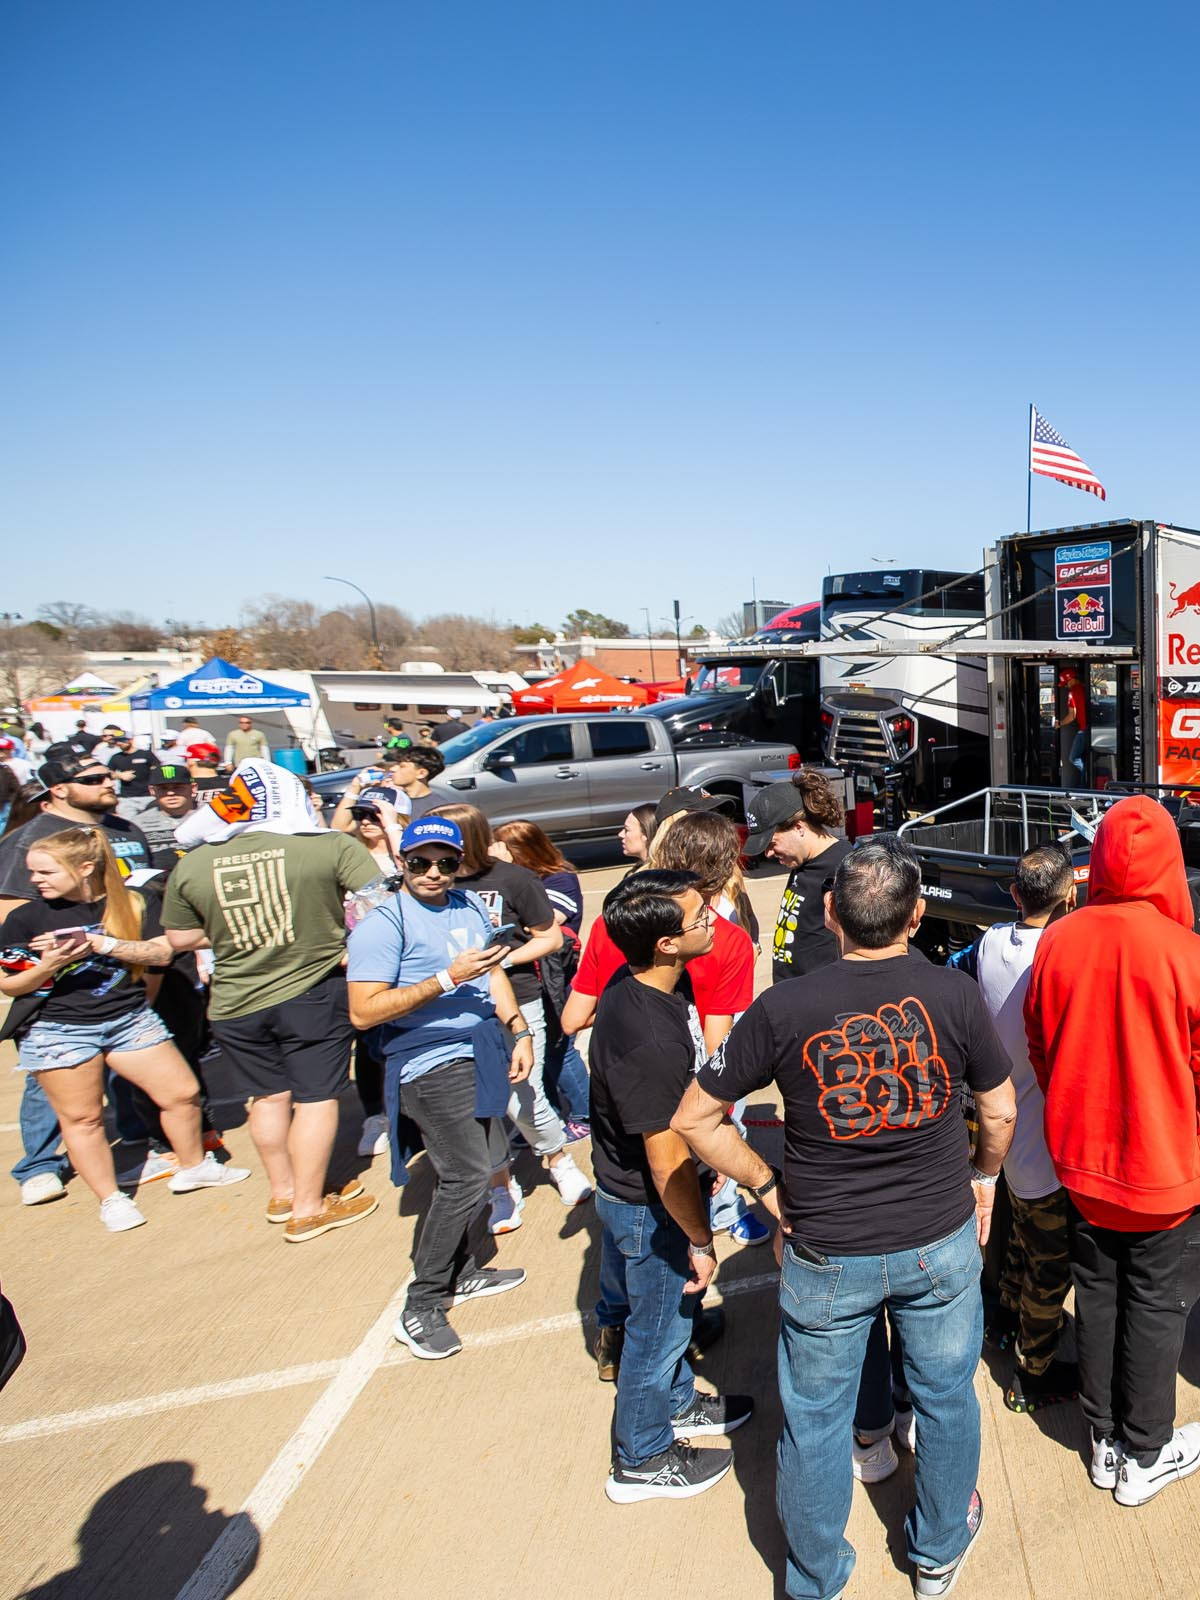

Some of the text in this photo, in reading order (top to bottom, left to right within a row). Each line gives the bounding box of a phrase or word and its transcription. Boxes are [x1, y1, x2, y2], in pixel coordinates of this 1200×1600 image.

[1063, 615, 1104, 632] Red Bull
[213, 848, 285, 867] FREEDOM
[920, 884, 952, 899] LARIS
